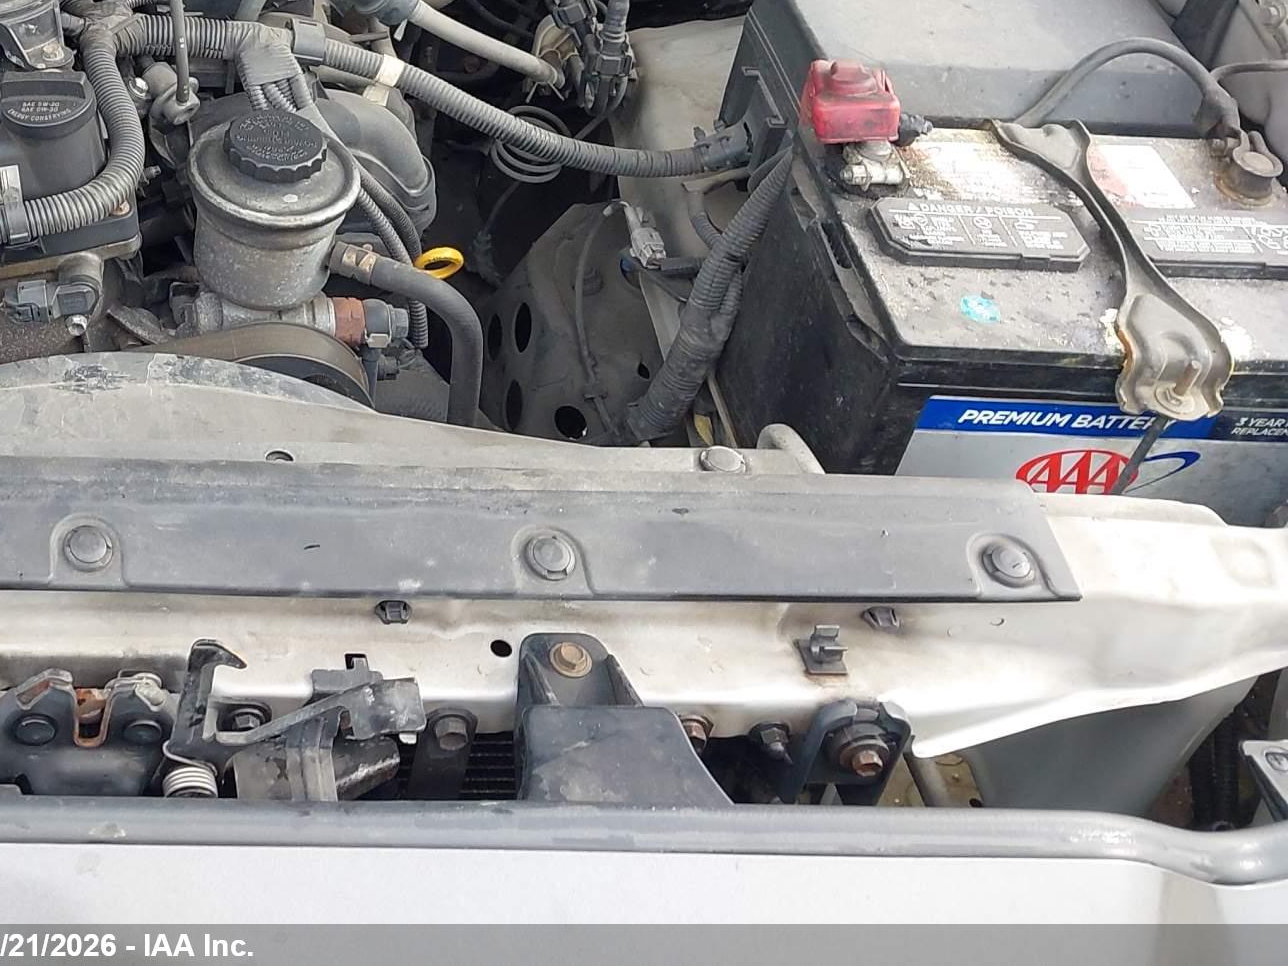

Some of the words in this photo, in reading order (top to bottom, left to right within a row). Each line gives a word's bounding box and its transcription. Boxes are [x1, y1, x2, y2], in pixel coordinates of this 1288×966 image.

[920, 202, 974, 215] DANGER
[986, 206, 1034, 218] POISON
[958, 409, 1073, 428] PREMIUM
[1235, 416, 1249, 427] 3
[1248, 417, 1287, 428] YEAR
[1016, 449, 1132, 495] AAA
